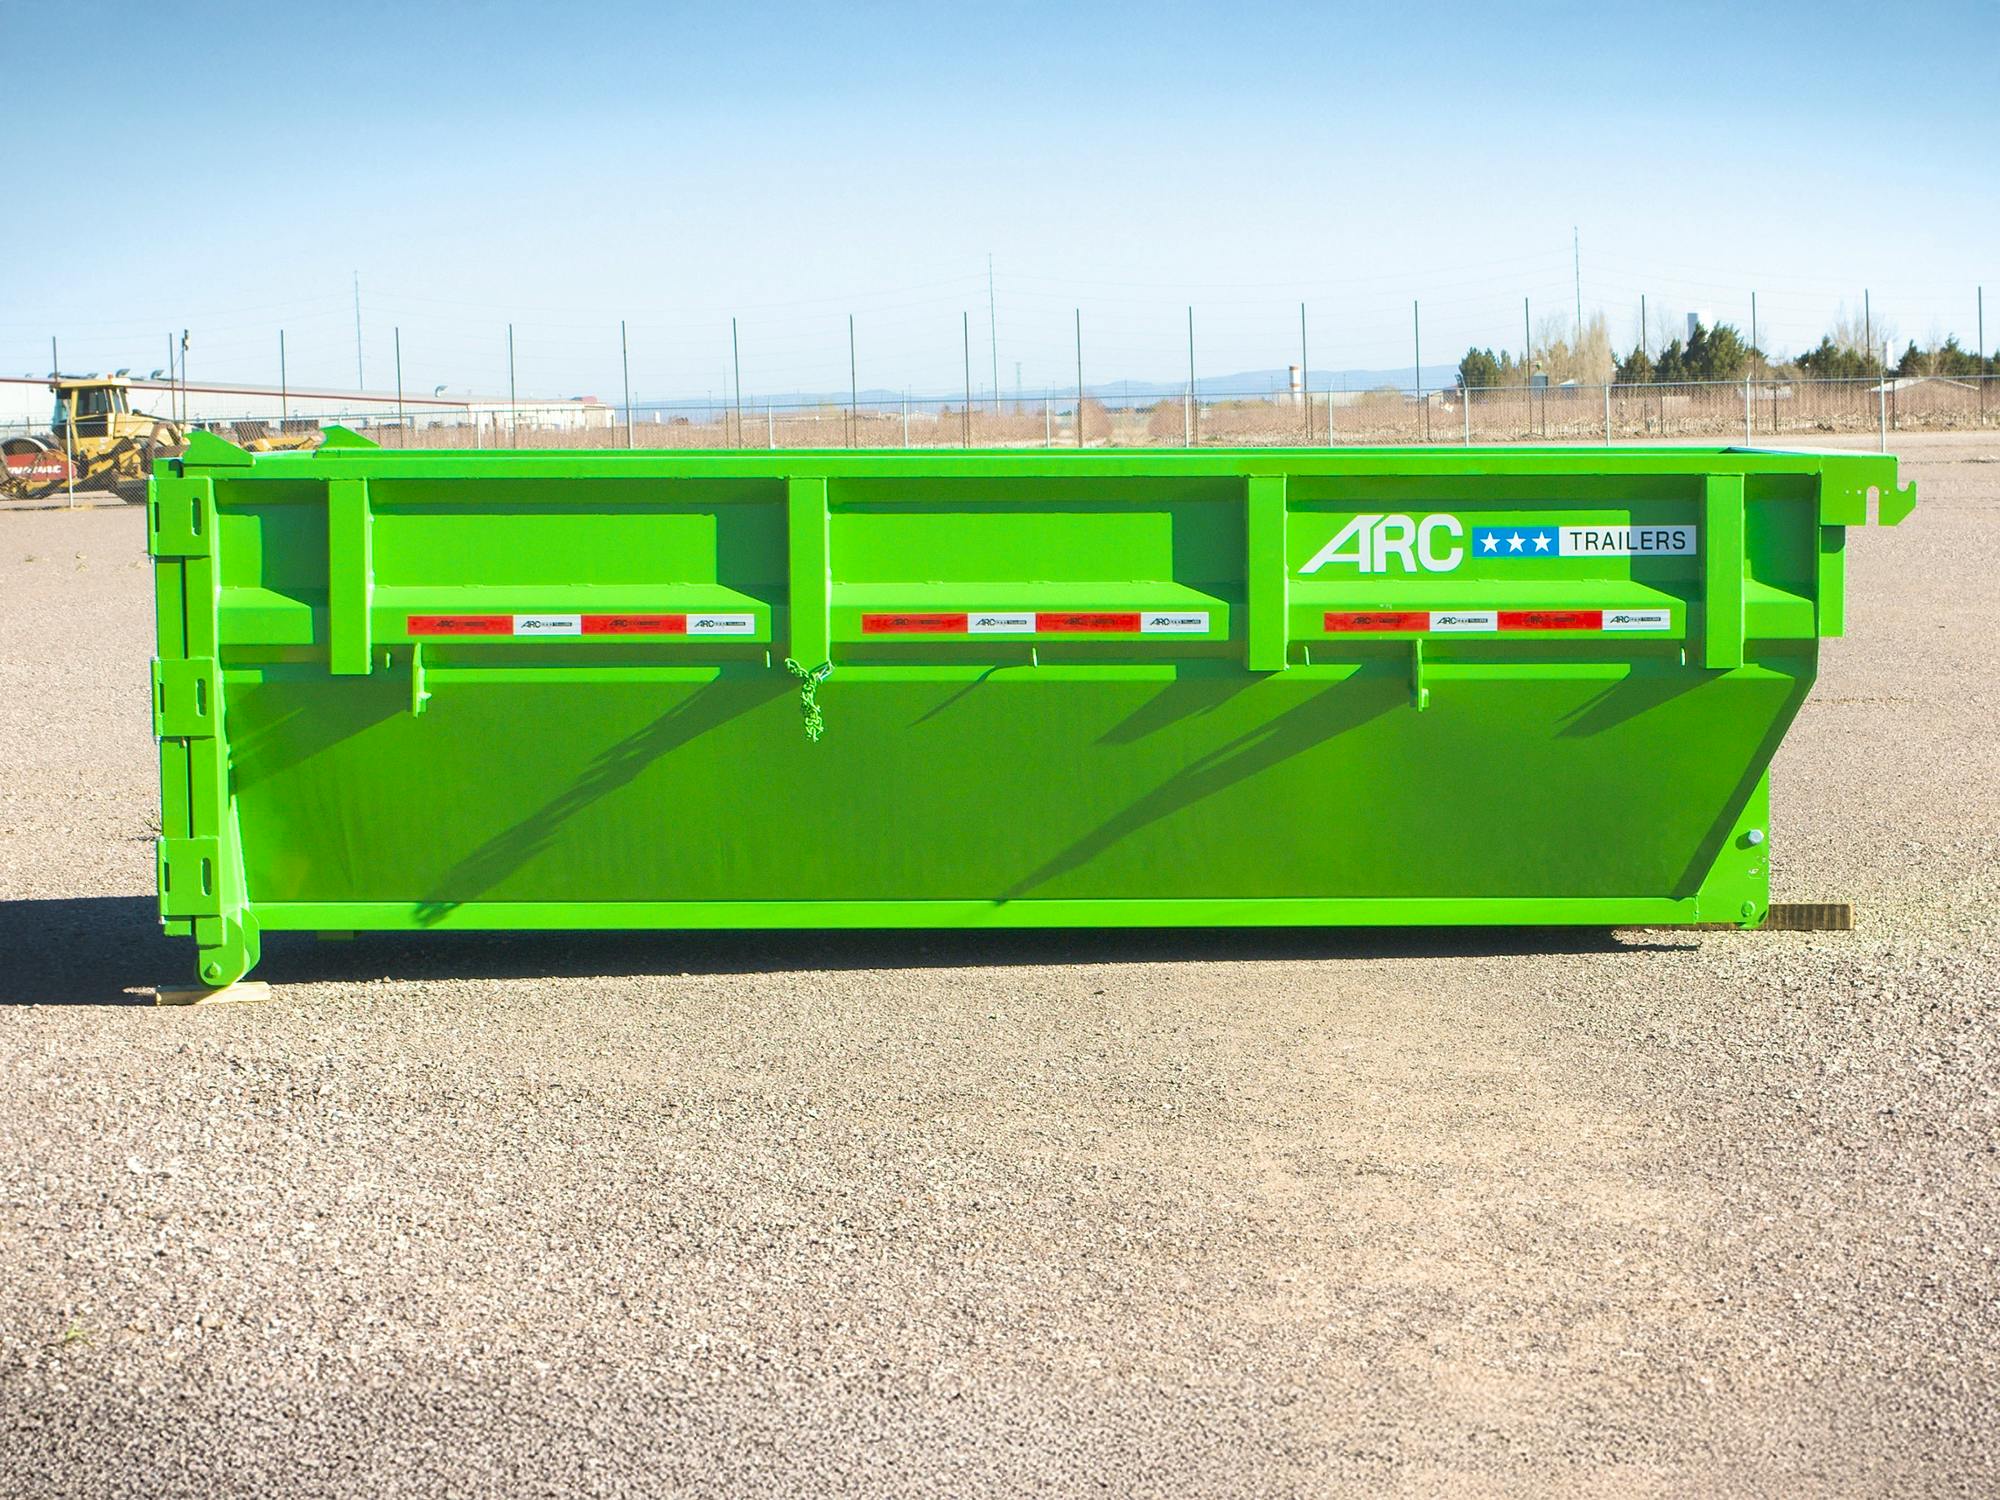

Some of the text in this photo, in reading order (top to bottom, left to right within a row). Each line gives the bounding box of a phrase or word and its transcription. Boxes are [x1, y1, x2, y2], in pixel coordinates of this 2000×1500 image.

[1297, 513, 1687, 574] ARC TRAILERS
[521, 620, 541, 628] ARC
[694, 619, 714, 628] ARC
[975, 618, 995, 626] ARC
[1149, 617, 1169, 626] ARC
[1437, 616, 1456, 625] ARC
[1610, 615, 1629, 624] ARC
